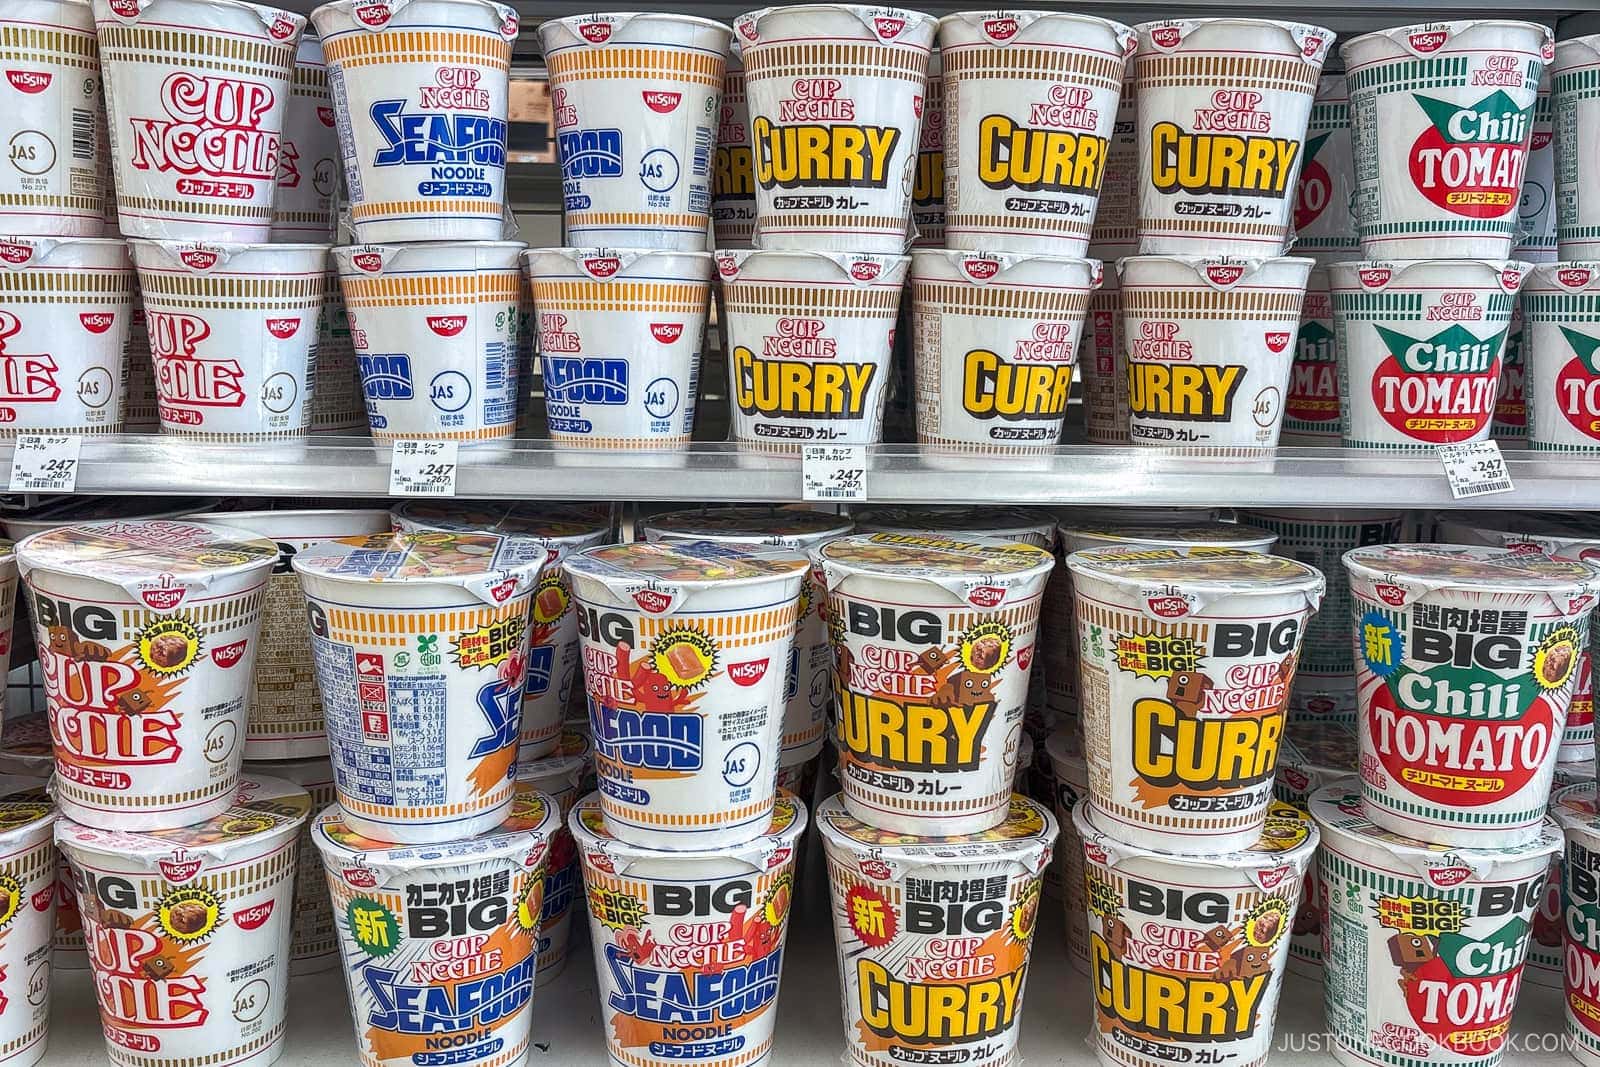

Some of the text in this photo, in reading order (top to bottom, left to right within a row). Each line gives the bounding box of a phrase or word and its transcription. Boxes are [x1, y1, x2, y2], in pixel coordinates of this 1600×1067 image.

[359, 6, 391, 20] NISSIN
[583, 24, 612, 37] NISSIN
[987, 21, 1017, 33] NISSIN
[1412, 34, 1445, 48] NISSIN
[1485, 55, 1518, 71] CUP
[11, 74, 48, 87] NISSIN
[435, 67, 481, 89] CUP
[792, 79, 841, 100] CUP
[1048, 84, 1093, 109] CUP
[160, 71, 275, 127] CUP
[419, 87, 490, 111] NOODLE
[647, 93, 678, 105] NISSIN
[1211, 90, 1262, 111] CUP
[779, 99, 855, 121] NOODLE
[1029, 104, 1098, 130] NOODLE
[1193, 109, 1271, 132] NOODLE
[1447, 110, 1527, 143] Chili
[8, 145, 36, 160] JAS
[753, 115, 901, 190] CURRY
[1151, 121, 1300, 198] CURRY
[432, 167, 485, 180] NOODLE
[639, 163, 663, 178] JAS
[180, 181, 252, 198] カップヌードル
[836, 196, 869, 210] カレー
[1008, 199, 1068, 214] カップヌードル
[1177, 203, 1271, 217] カップヌードル カレー
[184, 252, 214, 264] NISSIN
[588, 260, 618, 271] NISSIN
[968, 263, 996, 273] NISSIN
[1209, 269, 1241, 279] NISSIN
[1361, 271, 1389, 281] NISSIN
[1560, 272, 1589, 282] NISSIN
[1440, 292, 1477, 307] CUP
[84, 315, 111, 326] NISSIN
[270, 321, 297, 332] NISSIN
[431, 319, 464, 329] NISSIN
[776, 318, 825, 339] CUP
[653, 327, 681, 337] NISSIN
[1032, 323, 1070, 343] CUP
[1140, 321, 1180, 340] CUP
[763, 336, 837, 359] NOODLE
[1267, 337, 1289, 346] NISSIN
[1405, 343, 1489, 373] Chili
[76, 380, 99, 395] JAS
[733, 346, 878, 420] CURRY
[963, 349, 1074, 421] CURR
[260, 386, 283, 401] JAS
[429, 385, 453, 399] JAS
[643, 392, 665, 405] JAS
[1252, 401, 1270, 414] JAS
[816, 427, 847, 440] カレー
[1175, 429, 1210, 442] カレー
[147, 591, 181, 602] NISSIN
[636, 591, 667, 607] NISSIN
[1153, 598, 1188, 611] NISSIN
[848, 601, 942, 645] BIG
[1412, 603, 1528, 636] 謎肉増量
[1214, 619, 1298, 658] BIG
[1364, 624, 1391, 666] 新
[215, 644, 244, 660] NISSIN
[1146, 640, 1192, 655] BIG!
[1412, 628, 1522, 669] BIG
[862, 644, 922, 673] CUP
[1147, 656, 1193, 671] BIG!
[732, 662, 766, 677] NISSIN
[1225, 663, 1281, 689] CUP
[1398, 672, 1521, 718] Chili
[203, 736, 224, 753] JAS
[1132, 697, 1288, 790] CURR
[1374, 707, 1546, 771] TOMATO
[721, 758, 745, 775] JAS
[917, 779, 962, 796] カレー
[1405, 768, 1501, 791] チリトマトヌードル
[1175, 797, 1250, 811] カップヌードル
[164, 862, 198, 875] NISSIN
[1433, 871, 1467, 883] NISSIN
[406, 870, 510, 907] カニカマ増量
[905, 875, 1009, 904] 謎肉増量
[605, 895, 636, 912] BIG!
[652, 880, 752, 917] BIG
[1127, 880, 1230, 924] BIG
[237, 905, 272, 923] NISSIN
[408, 896, 509, 939] BIG
[852, 896, 885, 938] 新
[905, 900, 1004, 936] BIG
[1411, 902, 1459, 917] BIG!
[608, 911, 640, 926] BIG!
[1412, 917, 1459, 931] BIG!
[354, 908, 389, 947] 新
[669, 922, 732, 945] CUP
[1140, 921, 1206, 948] CUP
[429, 934, 489, 961] CUP
[925, 937, 984, 959] CUP
[604, 943, 784, 1024] SEAFOOD
[1090, 930, 1273, 1044] CURRY
[362, 953, 536, 1035] SEAFOOD
[857, 957, 1027, 1045] CURRY
[232, 998, 255, 1014] JAS
[426, 1029, 492, 1050] NOODLE
[662, 1024, 732, 1041] NOODLE
[417, 1040, 501, 1066] シーフードヌードル
[654, 1037, 741, 1056] シーフードヌードル
[891, 1043, 1005, 1063] カップヌードル カレー
[1114, 1027, 1238, 1066] カップヌードル カレー
